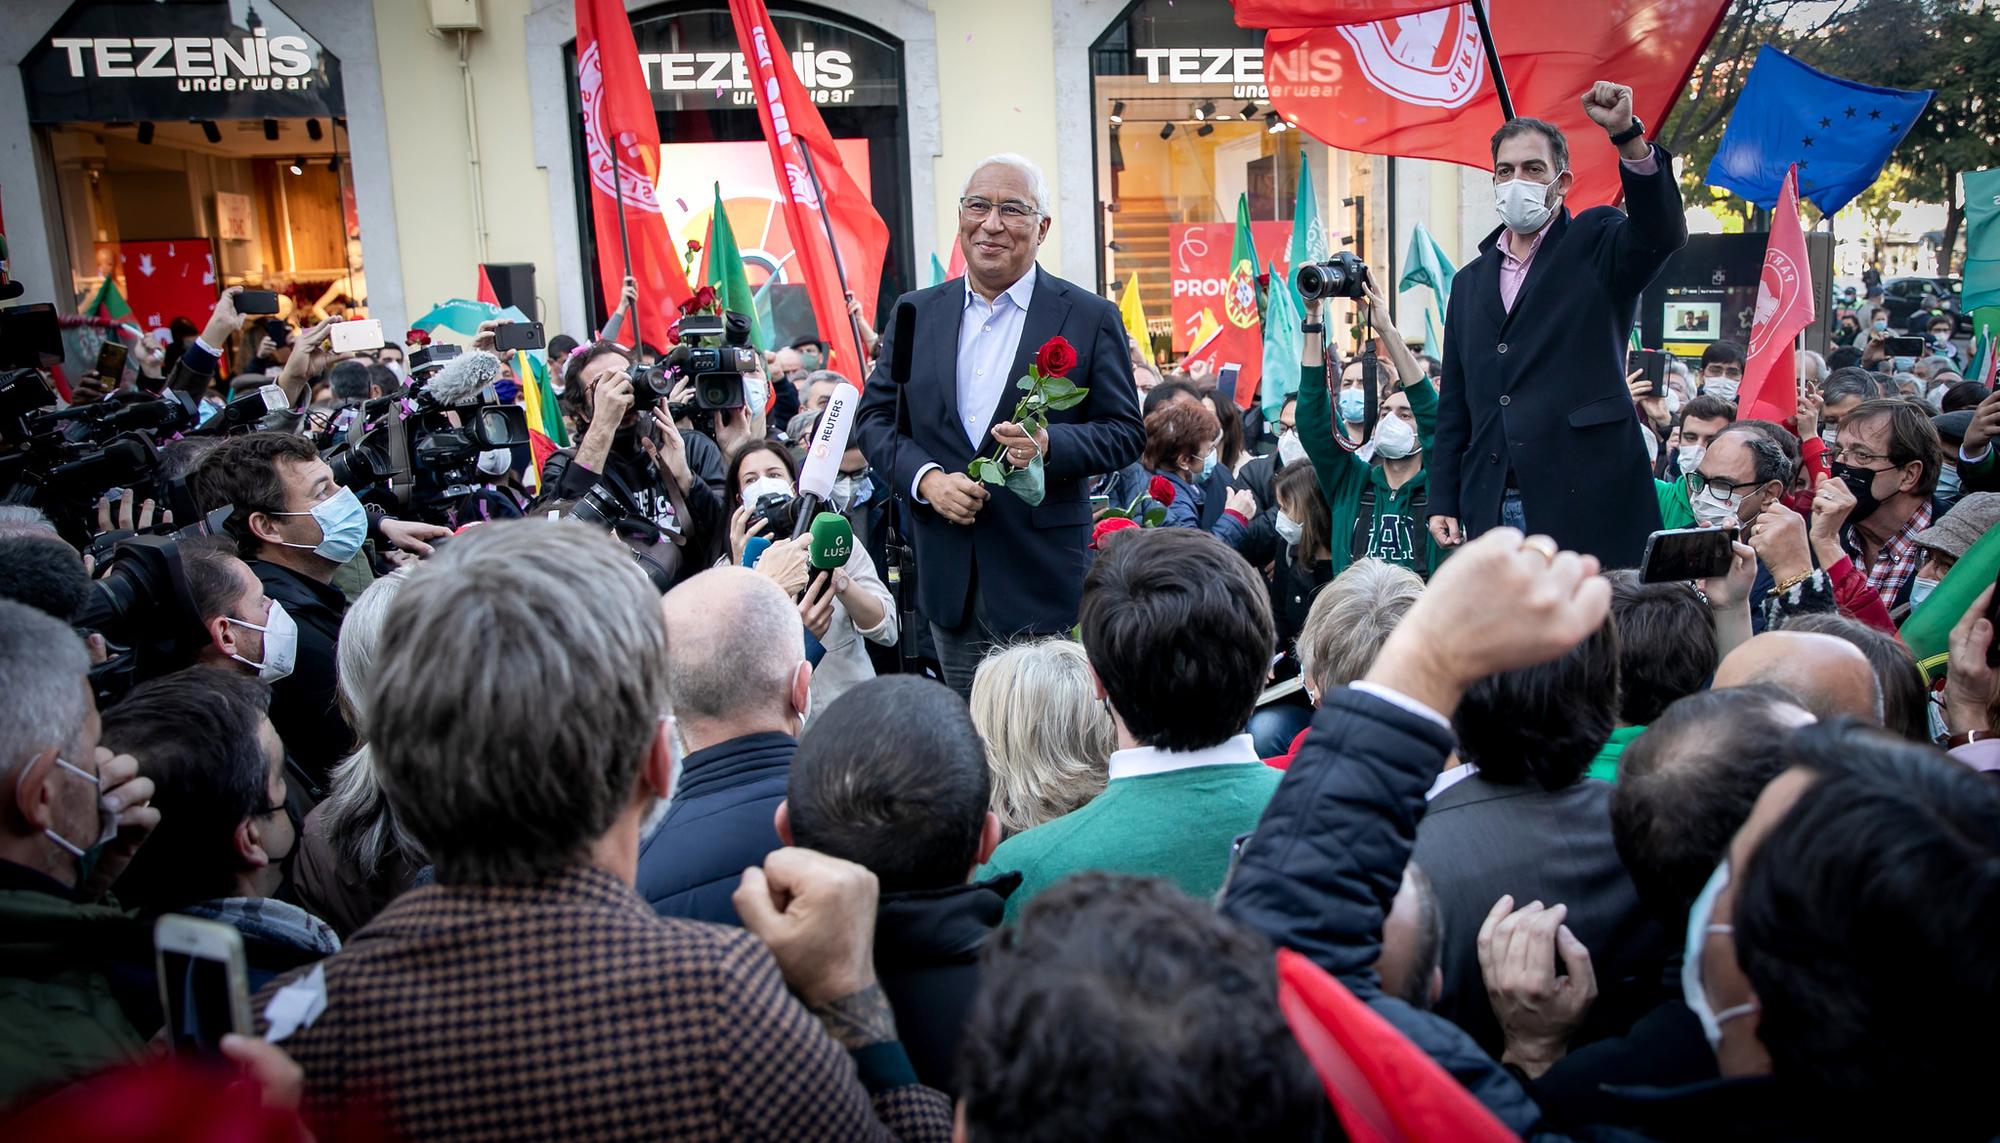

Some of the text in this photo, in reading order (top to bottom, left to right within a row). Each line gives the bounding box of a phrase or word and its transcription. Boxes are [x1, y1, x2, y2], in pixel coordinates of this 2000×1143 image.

[177, 76, 312, 92] underwear
[1233, 84, 1342, 98] underwear
[821, 399, 844, 442] REUTERS
[823, 547, 851, 557] LUSA
